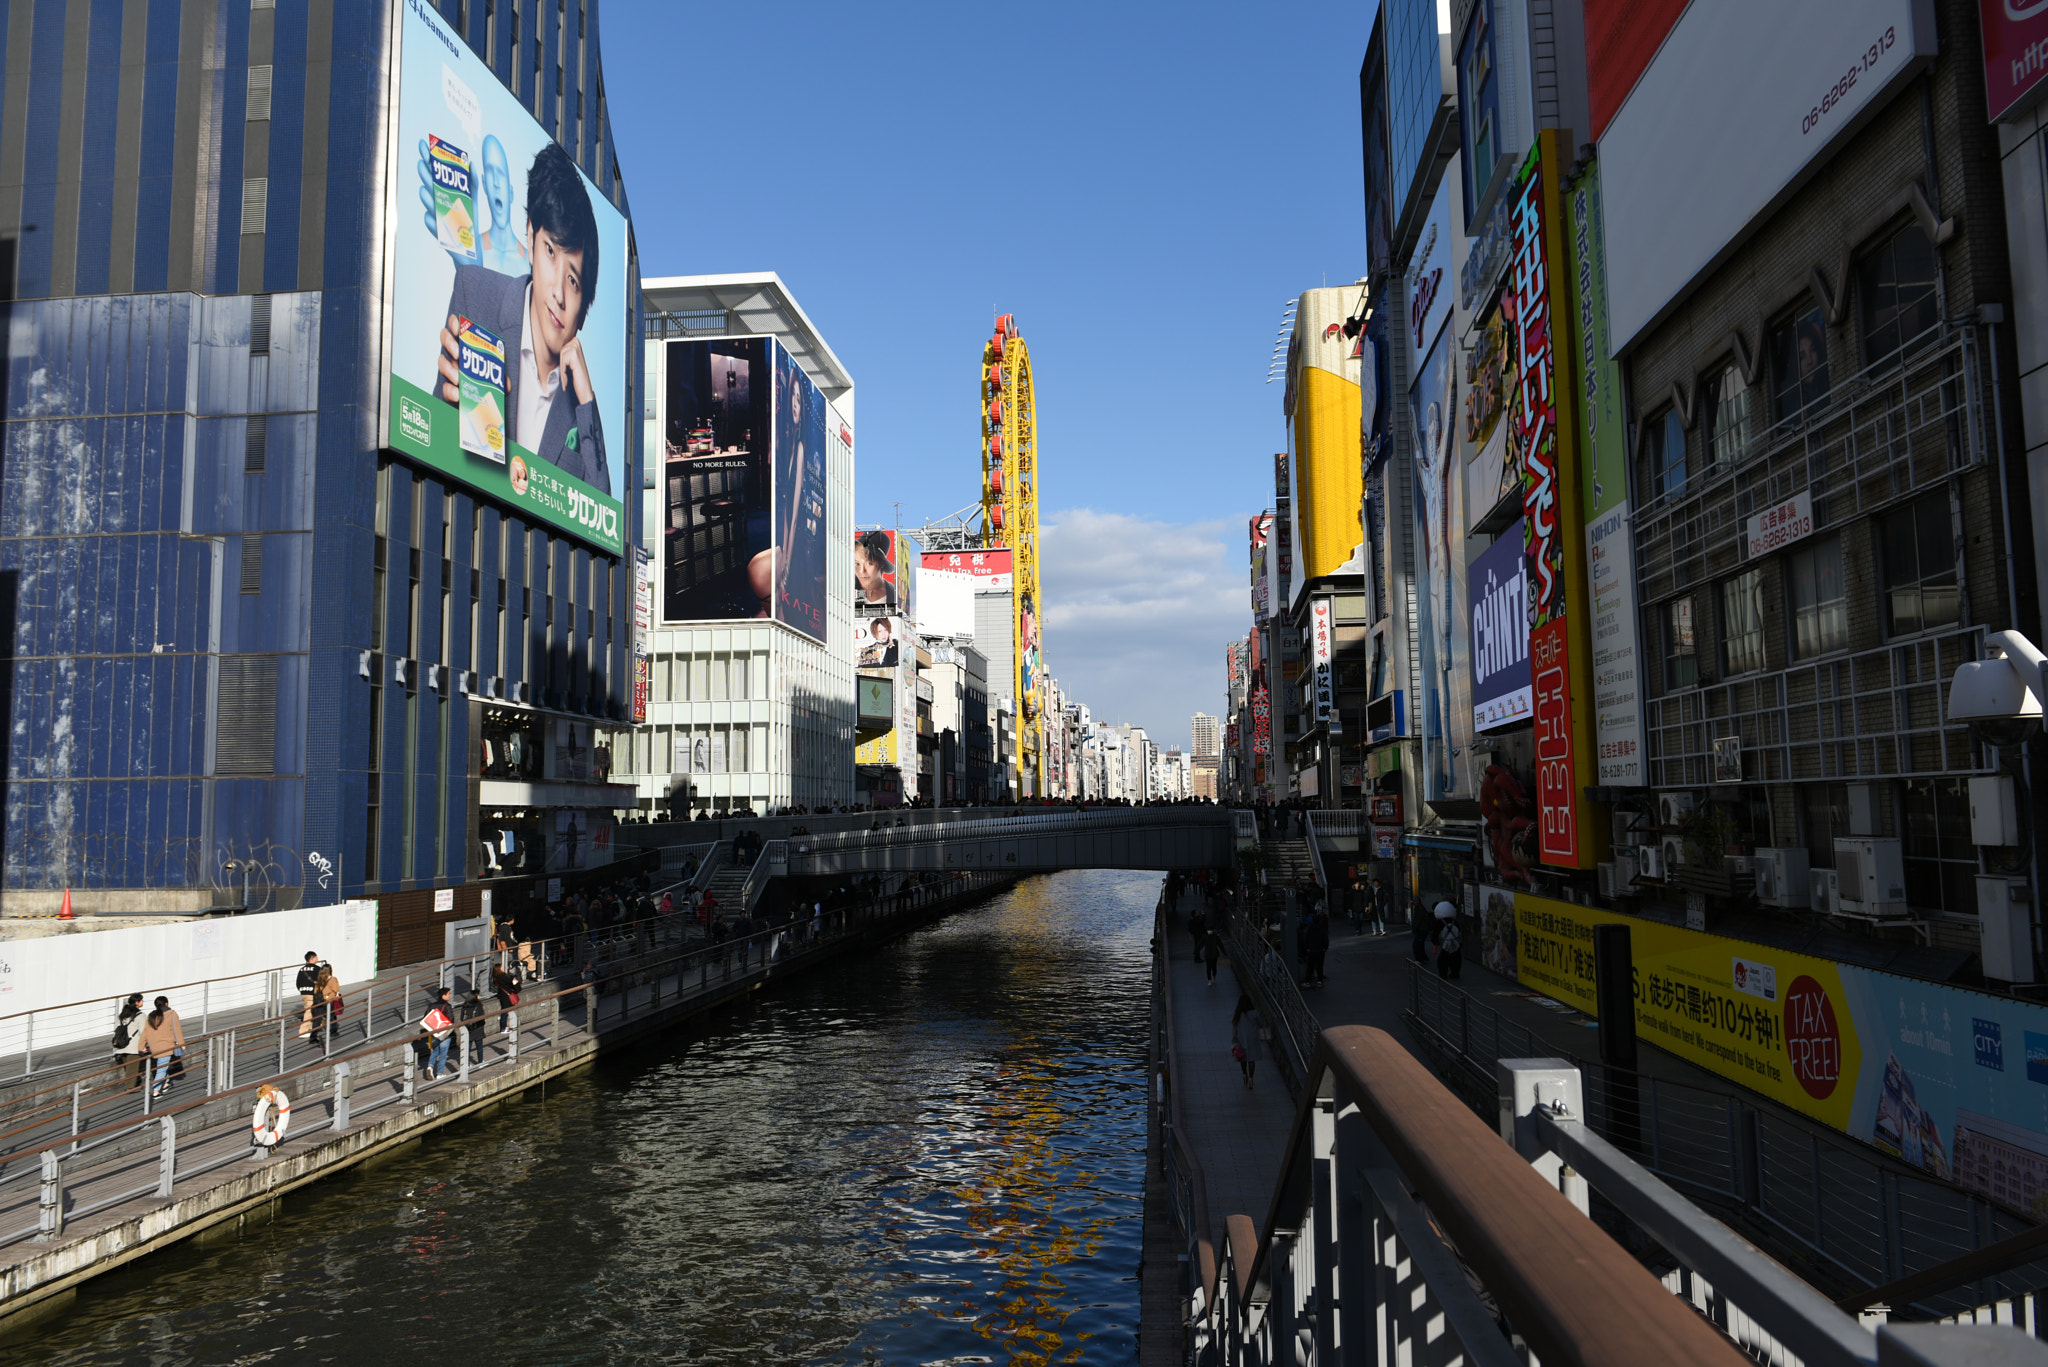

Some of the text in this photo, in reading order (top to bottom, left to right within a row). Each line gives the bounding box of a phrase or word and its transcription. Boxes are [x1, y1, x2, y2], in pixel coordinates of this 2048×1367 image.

[1802, 26, 1896, 135] 06-6262-1313
[433, 160, 471, 194] サロンパス
[462, 346, 504, 388] サロンパス
[1575, 187, 1603, 512] 株式会社日本リート
[567, 486, 619, 541] サロンパス
[1591, 513, 1621, 545] NIHON
[1760, 501, 1797, 532] 広告募集
[974, 567, 993, 575] Free
[1317, 619, 1328, 658] 本場の味
[1535, 629, 1562, 668] スーパー
[1789, 991, 1827, 1033] TAX
[1658, 1017, 1668, 1034] walk
[1669, 1021, 1681, 1040] from
[1682, 1026, 1694, 1045] here!
[1695, 1033, 1704, 1049] We
[1705, 1038, 1736, 1063] correspond
[1737, 1048, 1743, 1066] to
[1744, 1051, 1754, 1071] the
[1755, 1056, 1765, 1077] tax
[1767, 1061, 1783, 1084] free.
[1901, 1027, 1923, 1047] about
[1974, 1033, 2002, 1056] CITY
[1789, 1037, 1839, 1081] FREE!
